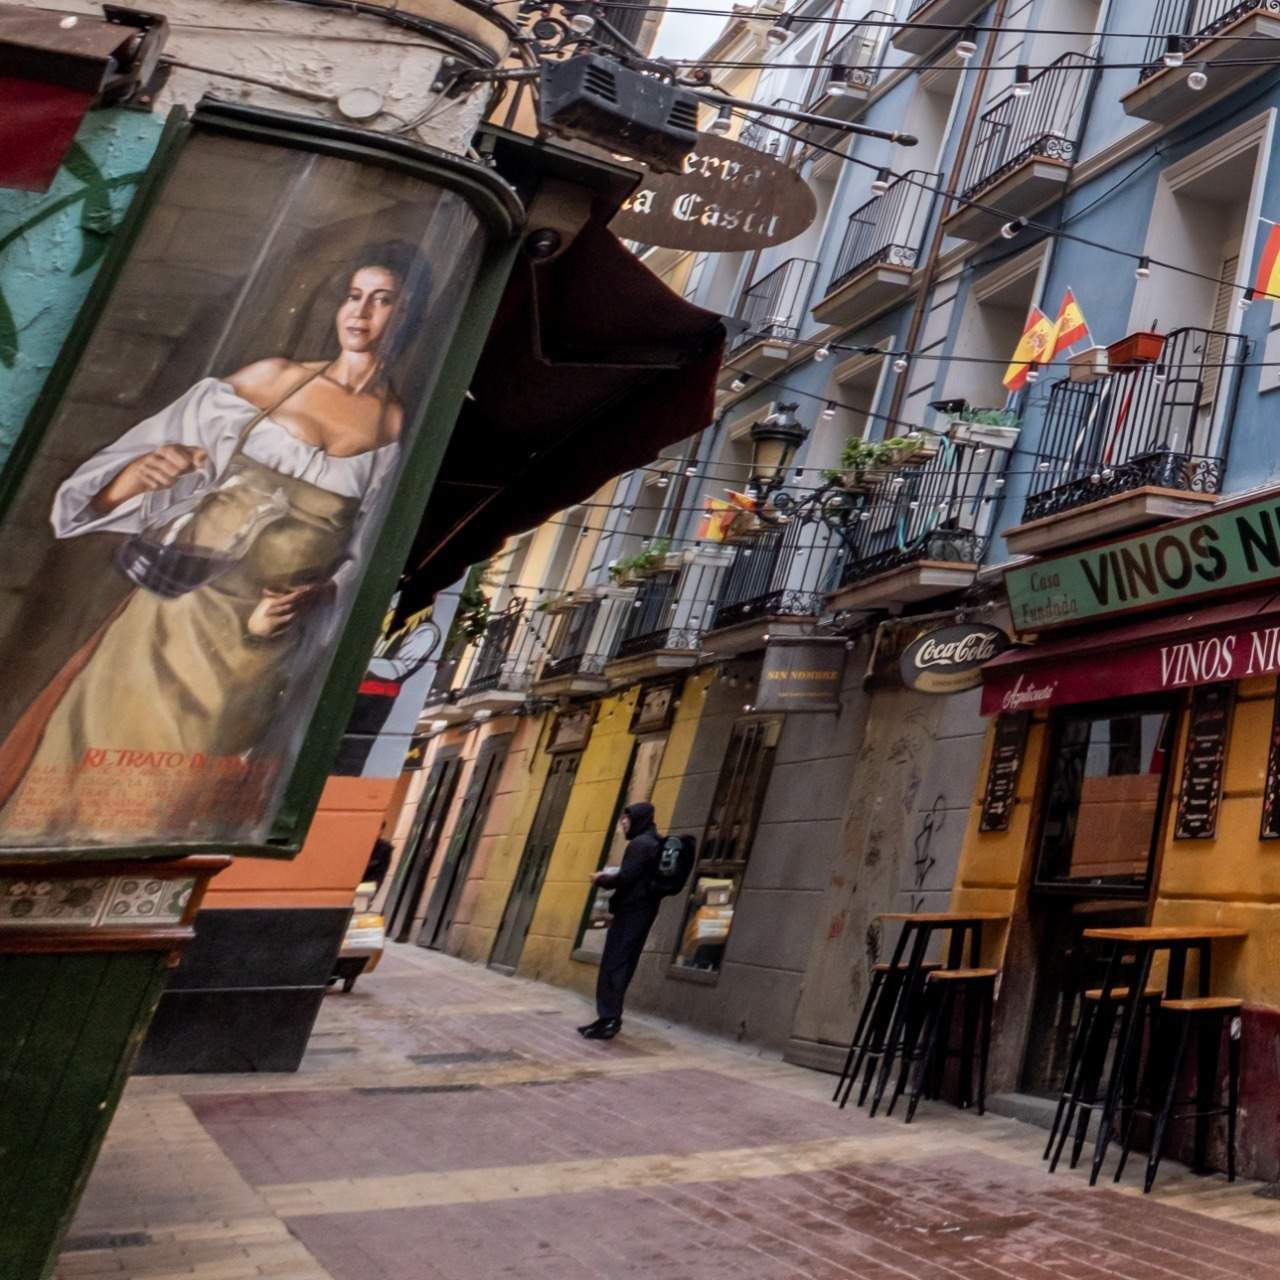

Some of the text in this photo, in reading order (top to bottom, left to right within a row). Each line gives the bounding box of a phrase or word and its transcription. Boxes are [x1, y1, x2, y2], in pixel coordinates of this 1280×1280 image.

[1029, 571, 1061, 593] Casa
[1080, 523, 1228, 607] VINOS
[914, 631, 1000, 668] Coca-Cola
[1160, 632, 1237, 688] VINOS
[80, 747, 184, 769] RETRATO
